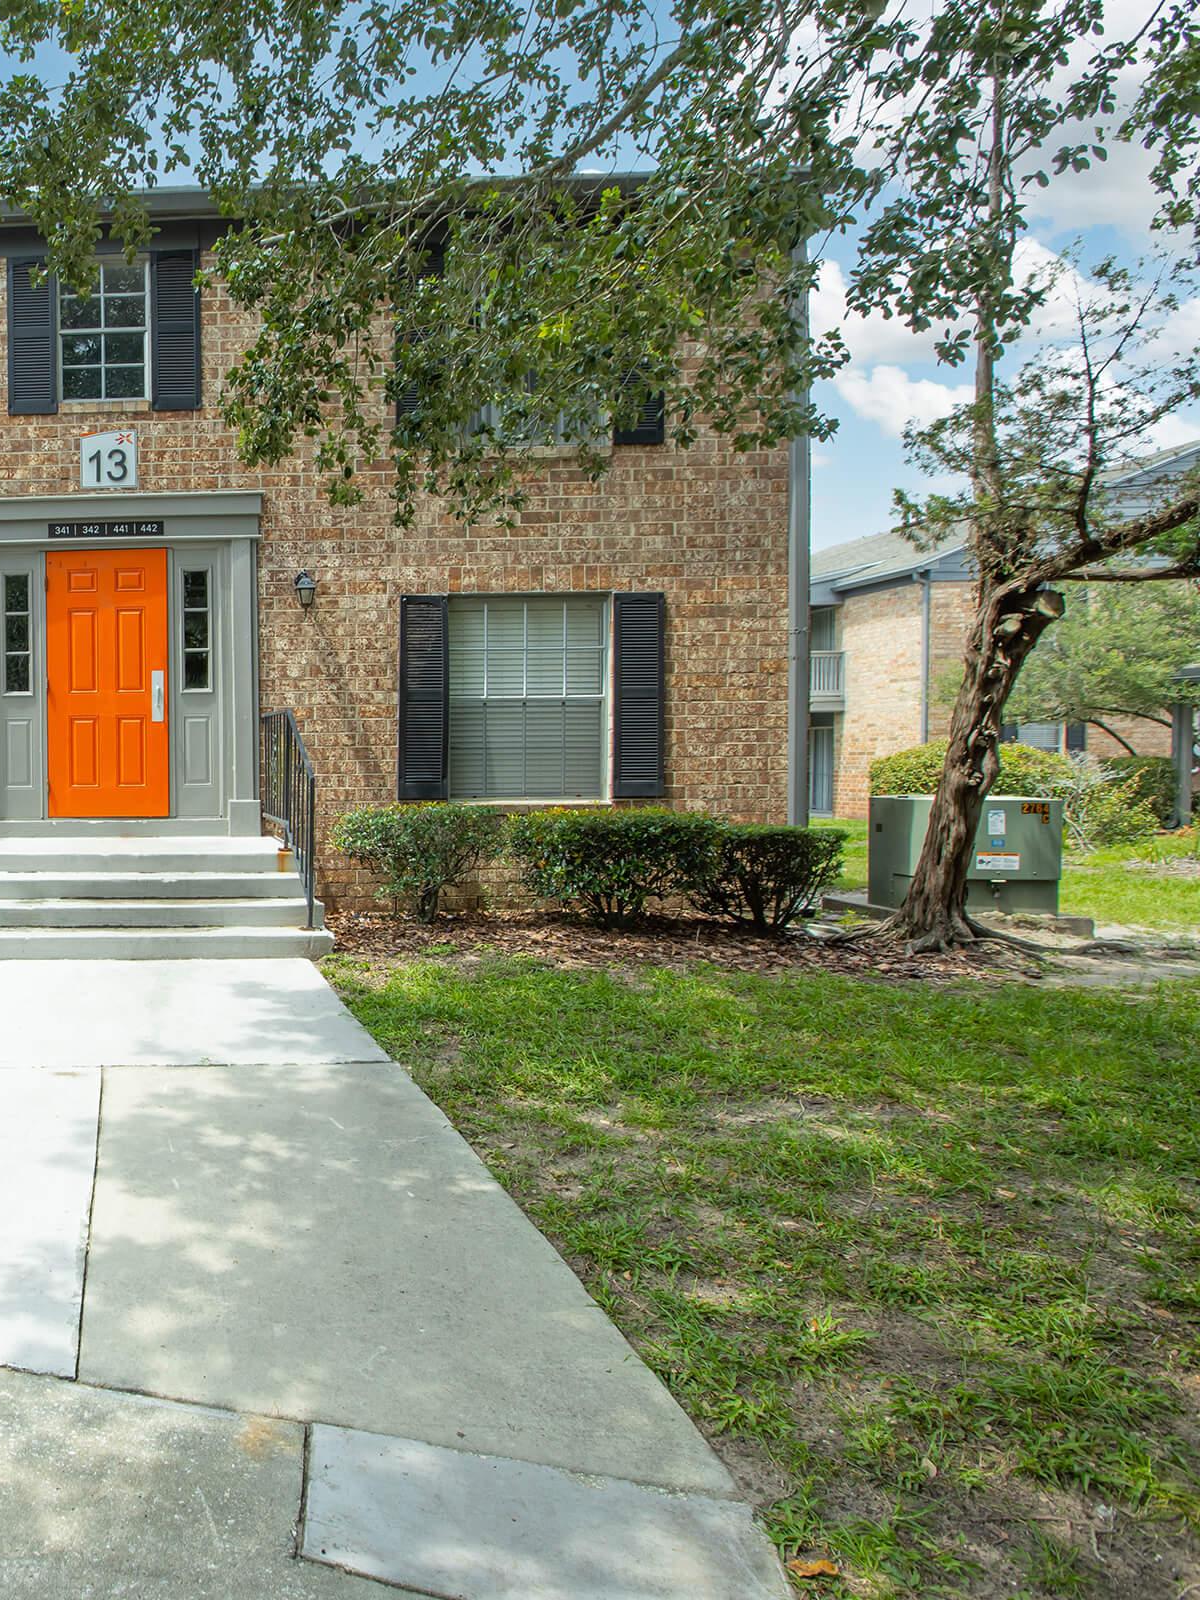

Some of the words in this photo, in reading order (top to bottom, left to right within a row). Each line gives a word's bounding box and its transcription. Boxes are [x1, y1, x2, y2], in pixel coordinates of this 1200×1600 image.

[88, 448, 128, 483] 13
[54, 526, 70, 535] 341
[82, 525, 100, 534] 342
[113, 524, 129, 533] 441
[140, 523, 157, 533] 442
